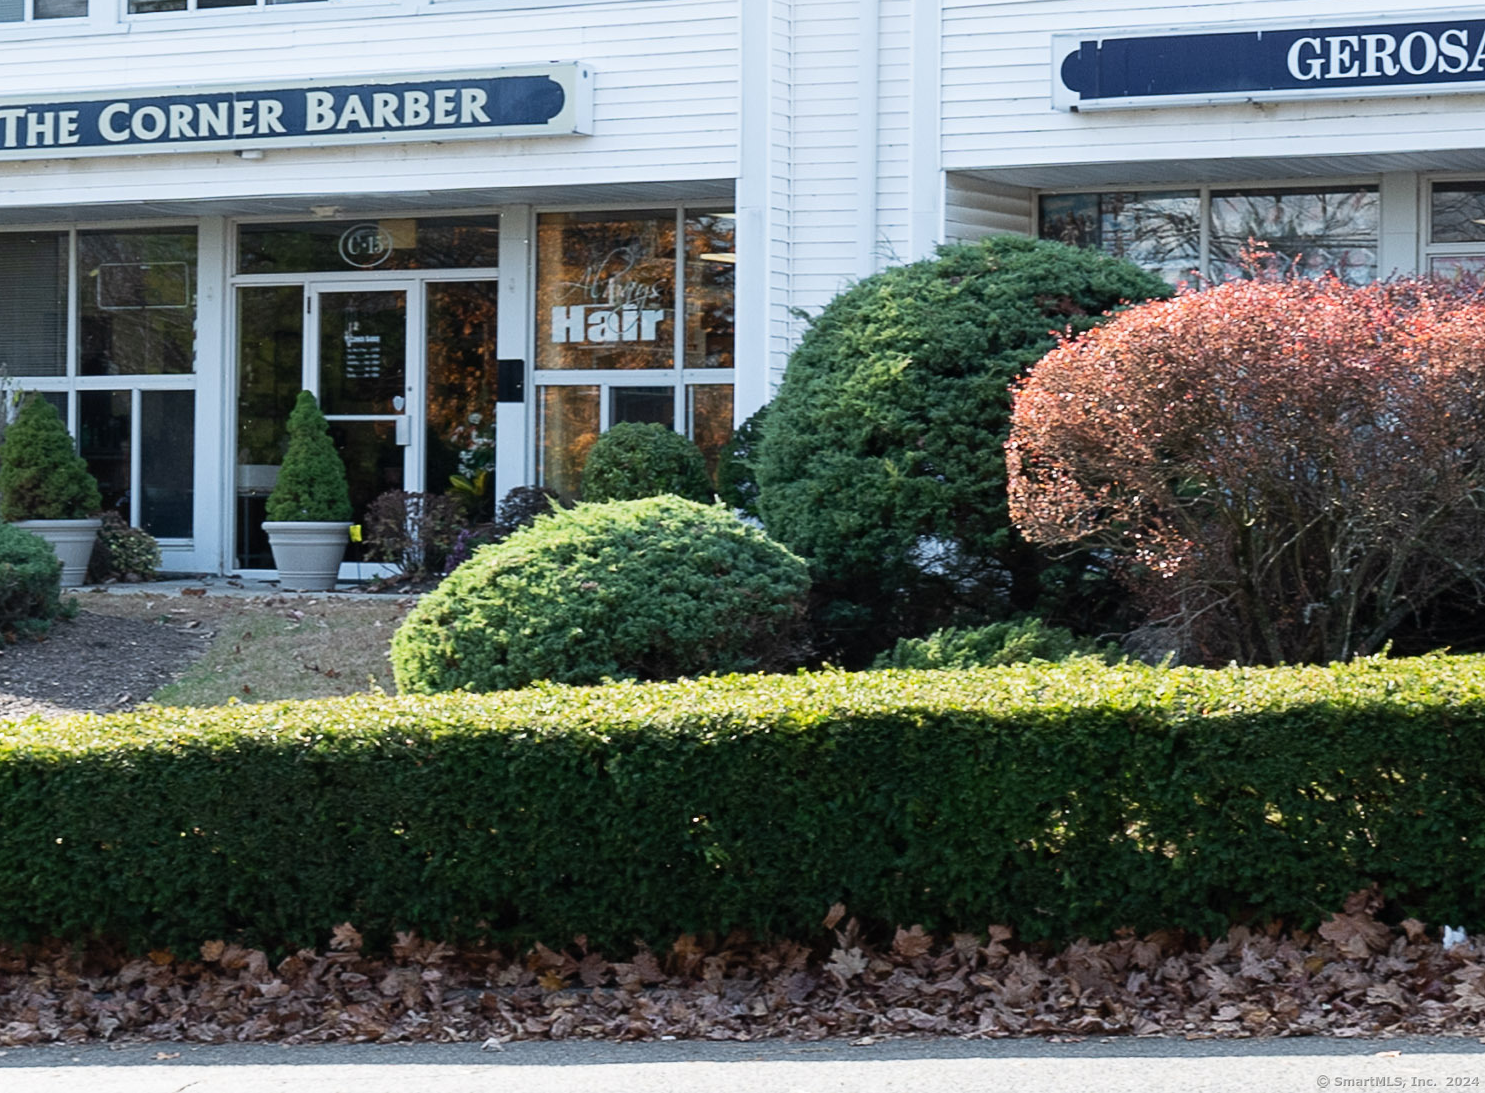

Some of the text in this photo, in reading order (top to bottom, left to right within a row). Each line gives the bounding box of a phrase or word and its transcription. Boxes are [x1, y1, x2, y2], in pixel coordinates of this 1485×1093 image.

[98, 99, 288, 143] CORNER
[305, 88, 491, 132] BARBER
[551, 304, 664, 343] Hair
